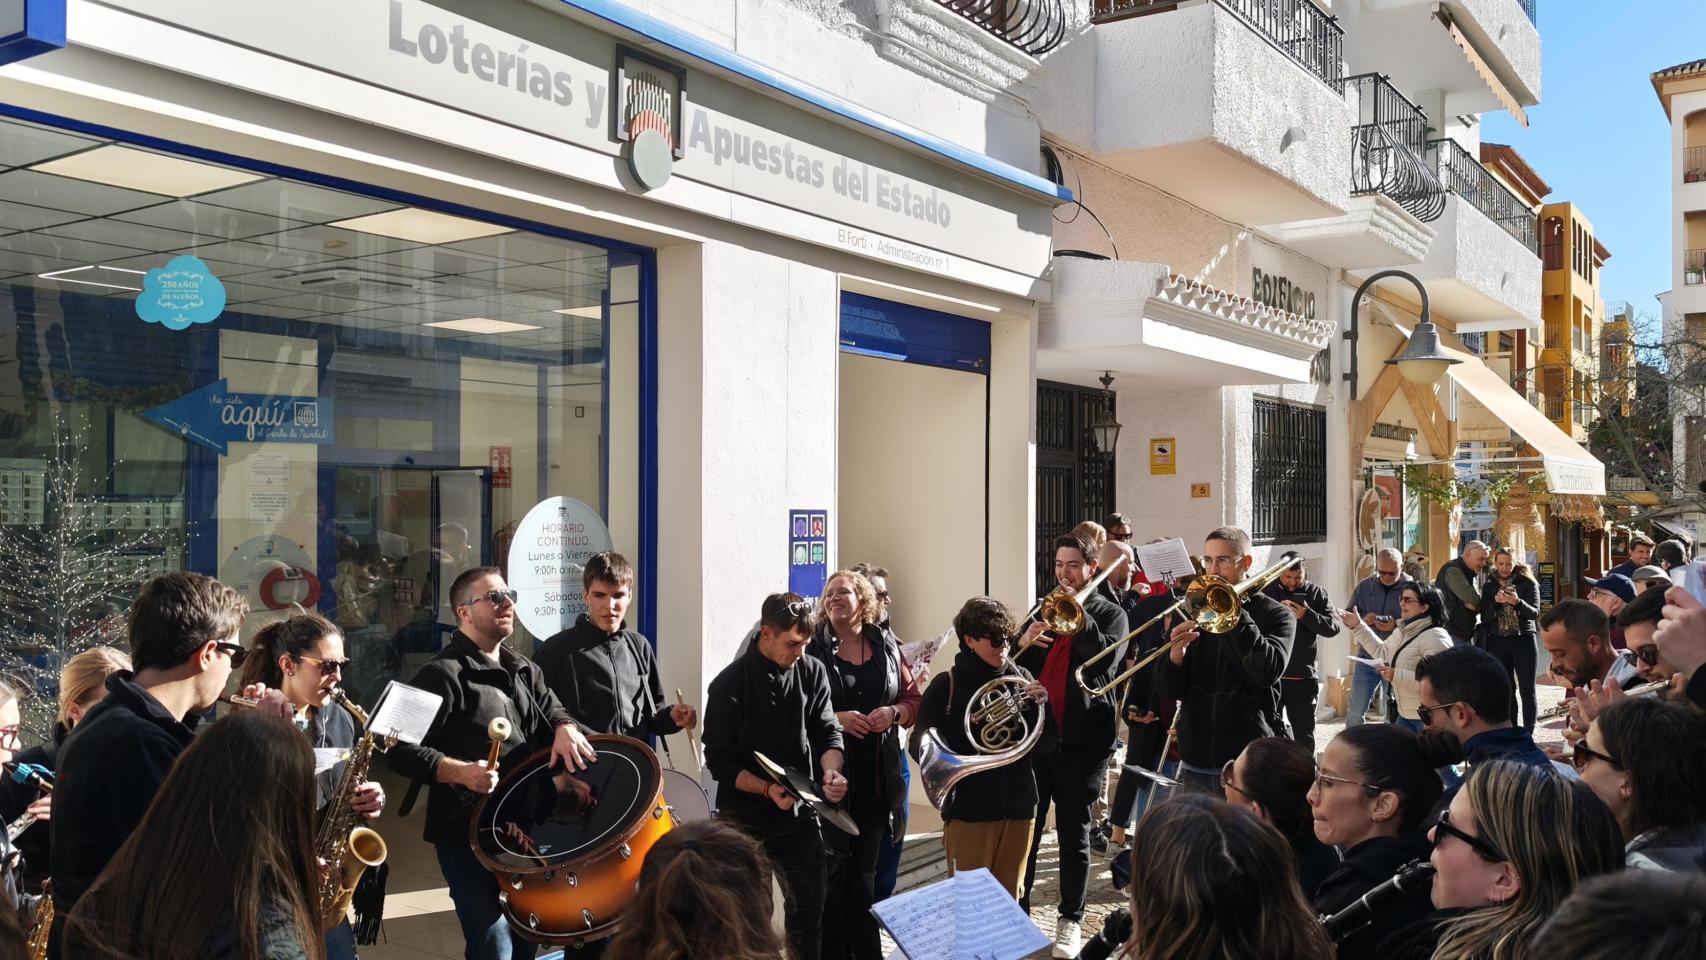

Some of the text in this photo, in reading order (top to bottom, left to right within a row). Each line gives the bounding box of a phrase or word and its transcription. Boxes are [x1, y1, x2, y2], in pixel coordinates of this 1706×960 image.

[389, 0, 606, 130] Loterías y
[688, 108, 951, 229] Apuestas del Estado
[838, 228, 846, 243] El
[877, 240, 934, 267] Administración
[945, 258, 950, 272] 1
[162, 280, 200, 289] 250 AÑOS
[221, 400, 284, 441] aquí
[542, 523, 584, 534] HORARIO
[537, 535, 589, 547] CONTINUO
[528, 551, 555, 562] Lunes
[557, 552, 563, 560] a
[534, 566, 557, 576] 9:00h
[559, 566, 565, 575] a
[544, 591, 583, 603] Sábados
[534, 606, 557, 617] 9:30h
[559, 606, 566, 615] a
